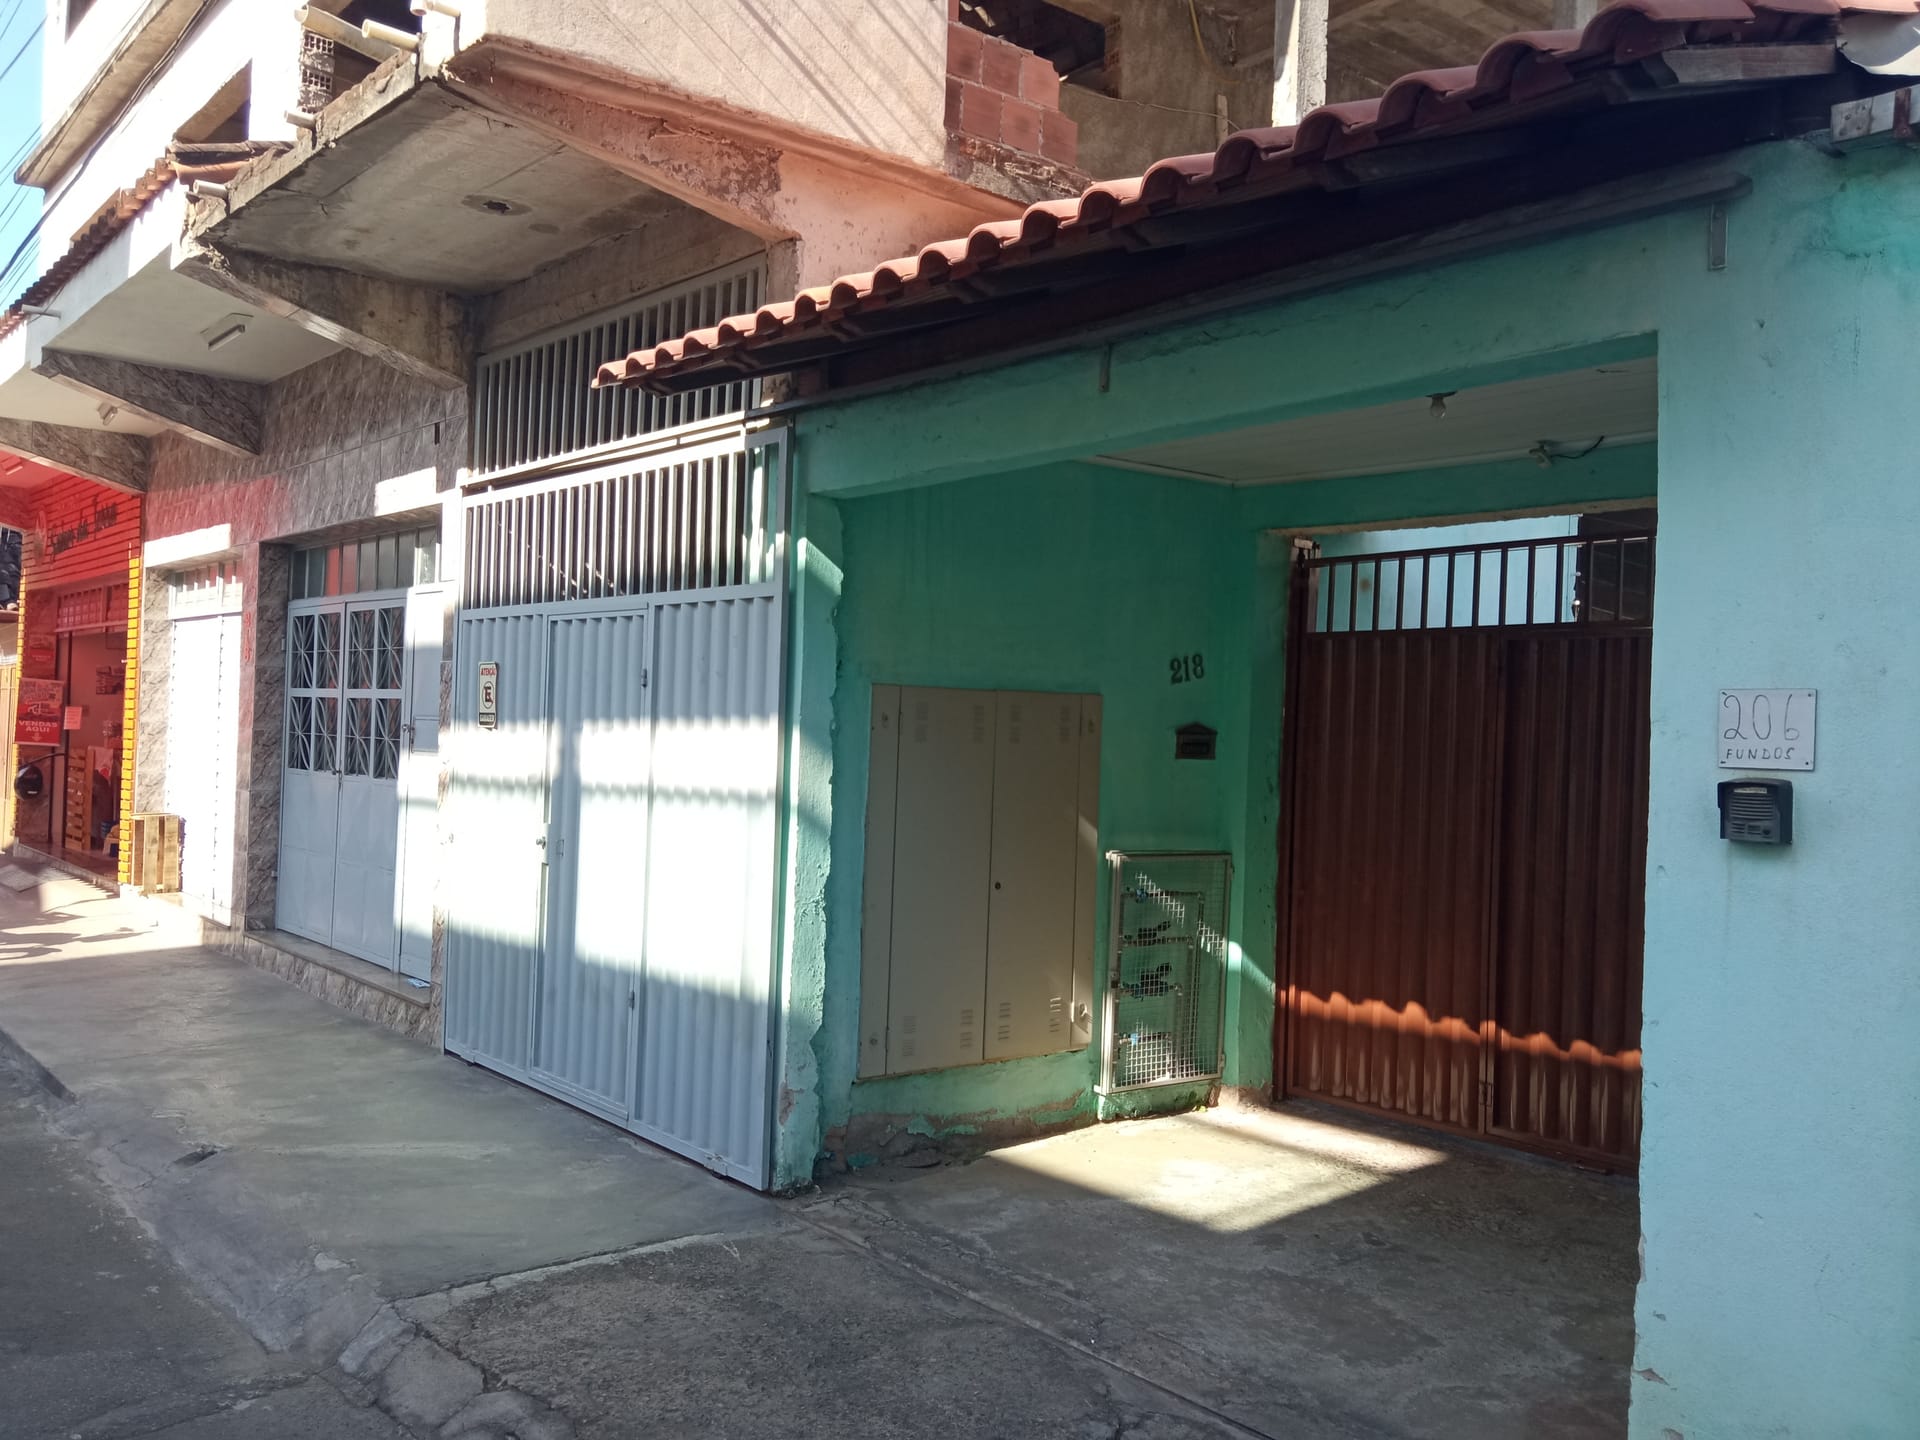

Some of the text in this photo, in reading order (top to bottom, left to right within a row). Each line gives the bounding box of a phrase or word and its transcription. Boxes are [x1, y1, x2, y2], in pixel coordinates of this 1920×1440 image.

[1170, 654, 1204, 684] 218
[19, 719, 58, 729] VENDAS
[1723, 693, 1800, 741] 206
[1726, 746, 1795, 760] FUNDOS
